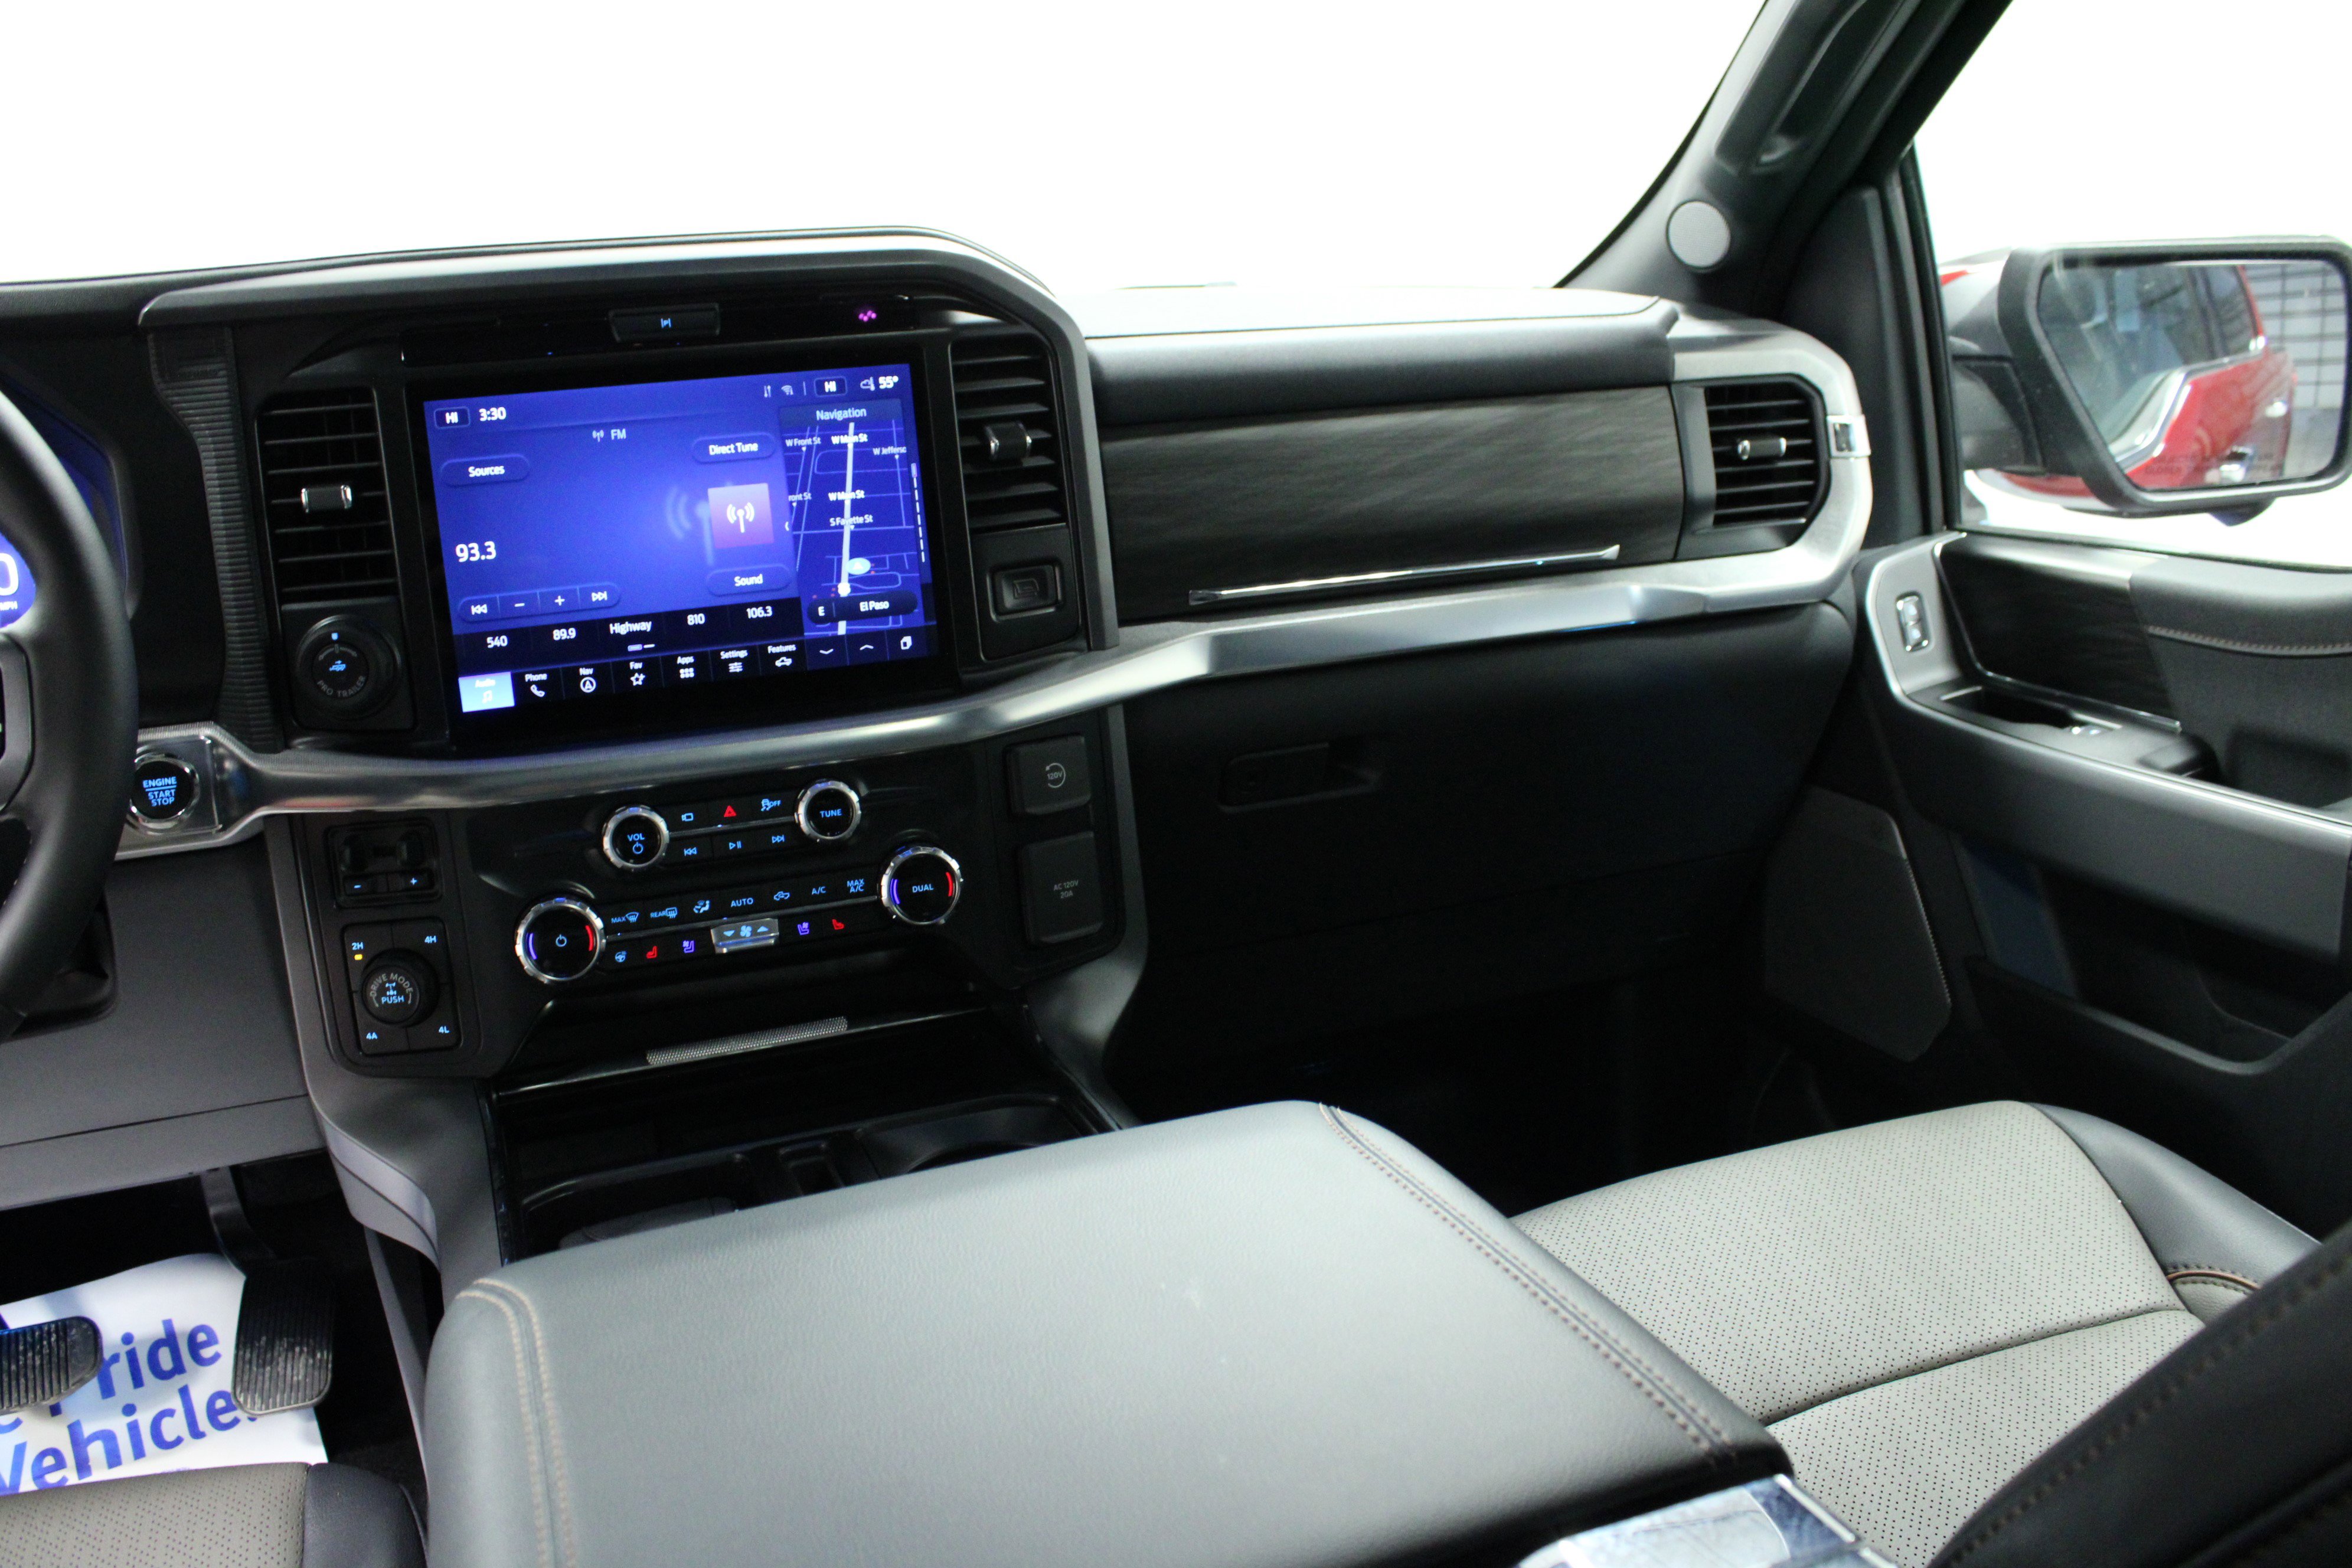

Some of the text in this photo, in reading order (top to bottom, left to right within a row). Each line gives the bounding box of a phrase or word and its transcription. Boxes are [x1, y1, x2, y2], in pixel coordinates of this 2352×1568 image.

[825, 381, 837, 393] HI
[878, 375, 899, 389] 55°
[445, 412, 458, 424] HI
[479, 407, 507, 422] 3:30
[816, 407, 867, 421] Navigation
[610, 429, 626, 440] FM
[831, 433, 868, 445] W Main St
[786, 436, 821, 447] W Front St
[709, 442, 759, 456] Direct Tune
[873, 447, 880, 456] W
[468, 464, 505, 477] Sources
[803, 492, 812, 500] St
[828, 489, 865, 501] W Main St
[829, 514, 873, 527] S Fayette St
[455, 541, 496, 563] 93.3
[734, 574, 763, 587] Sound
[818, 607, 825, 616] E
[860, 600, 890, 612] El Paso
[746, 606, 773, 619] 106.3
[687, 613, 705, 626] 810
[610, 620, 652, 636] Highway
[553, 628, 577, 641] 89.9
[486, 635, 508, 649] 540
[767, 643, 796, 654] Features
[677, 655, 695, 666] Apps
[720, 649, 749, 661] Settings
[630, 661, 643, 671] Fav
[525, 672, 547, 683] Phone
[580, 667, 593, 677] Nav
[1047, 770, 1063, 780] 120V
[142, 776, 177, 788] ENGINE
[148, 789, 176, 800] START
[151, 797, 175, 807] STOP
[820, 809, 842, 818] TUNE
[628, 833, 645, 842] VOL
[847, 878, 865, 887] MAX
[812, 886, 827, 895] A/C
[850, 885, 864, 893] A/C
[912, 884, 934, 893] DUAL
[731, 897, 754, 907] AUTO
[424, 936, 437, 944] 4H
[352, 942, 364, 950] 2H
[370, 972, 413, 997] DRIVE MODE
[381, 995, 404, 1004] PUSH
[439, 1026, 450, 1034] 4L
[366, 1032, 378, 1040] 4A
[50, 1318, 222, 1417] ride
